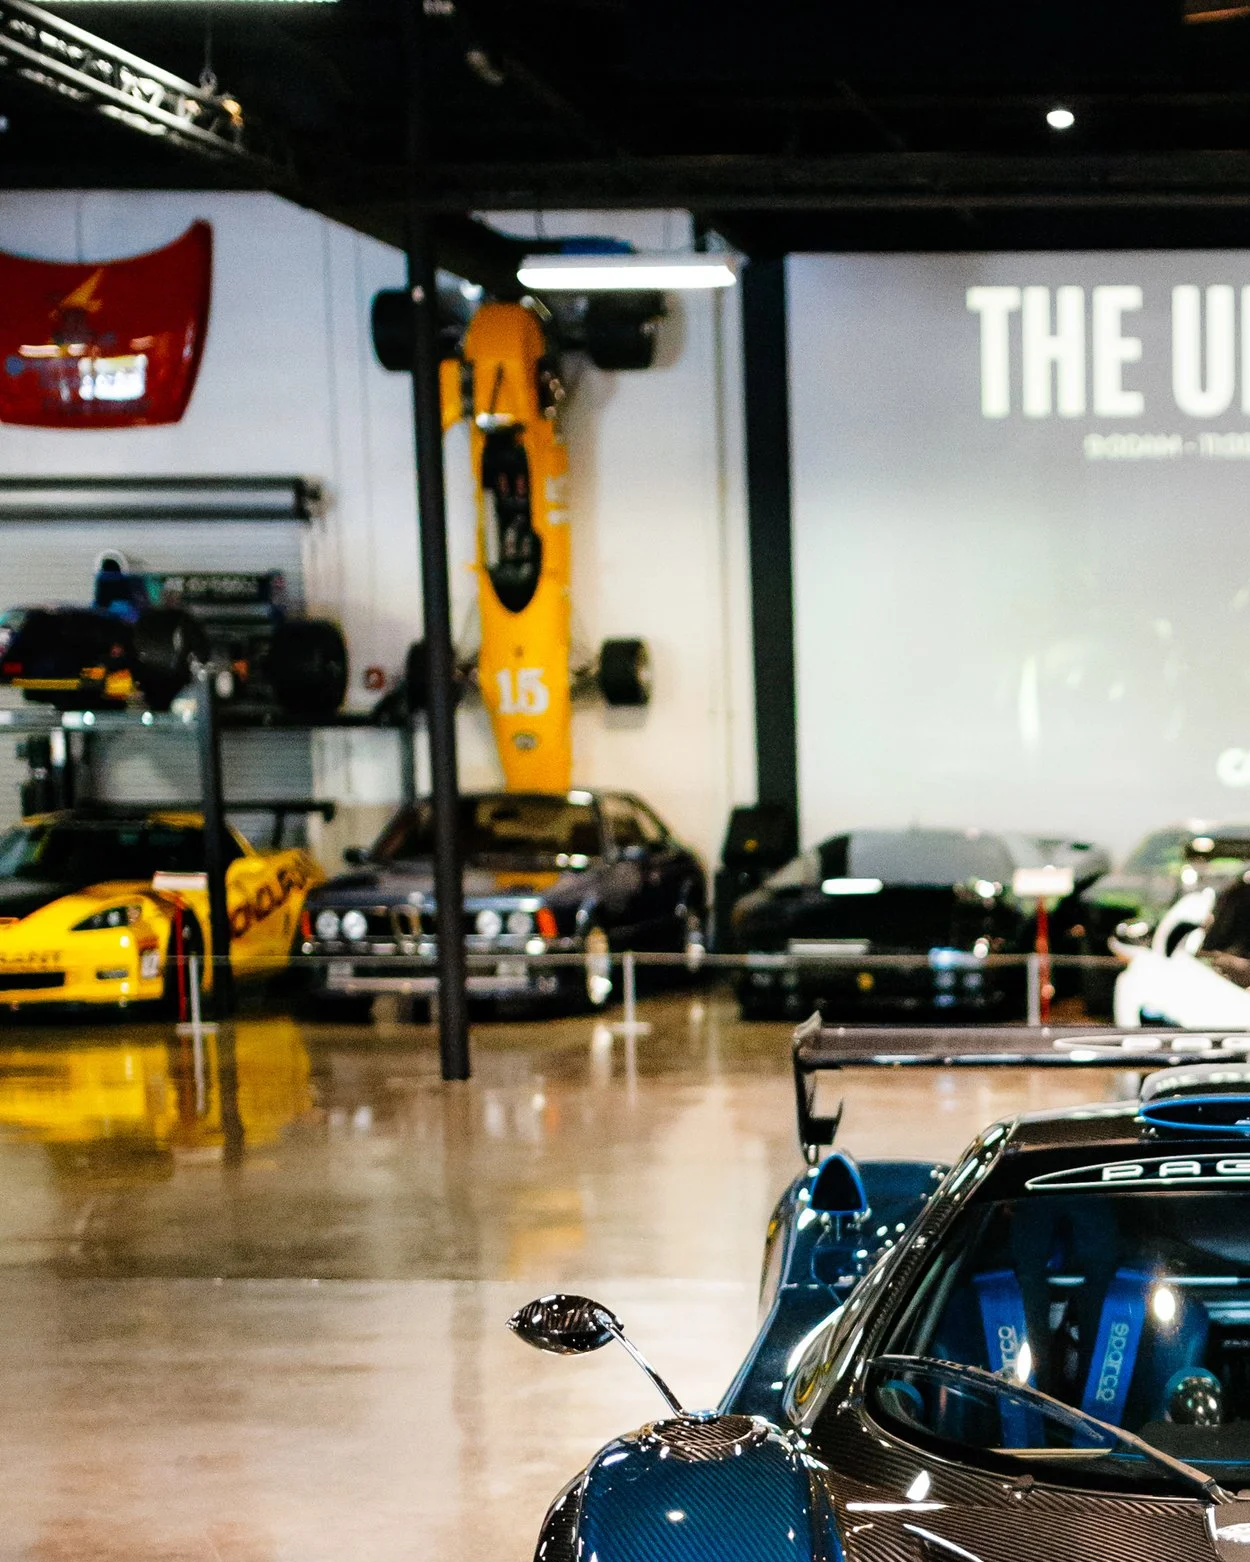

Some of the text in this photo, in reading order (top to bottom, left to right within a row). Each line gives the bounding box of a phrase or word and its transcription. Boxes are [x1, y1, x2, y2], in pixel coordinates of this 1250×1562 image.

[966, 283, 1146, 418] THE
[496, 666, 549, 716] 15
[1096, 1322, 1130, 1401] sparco
